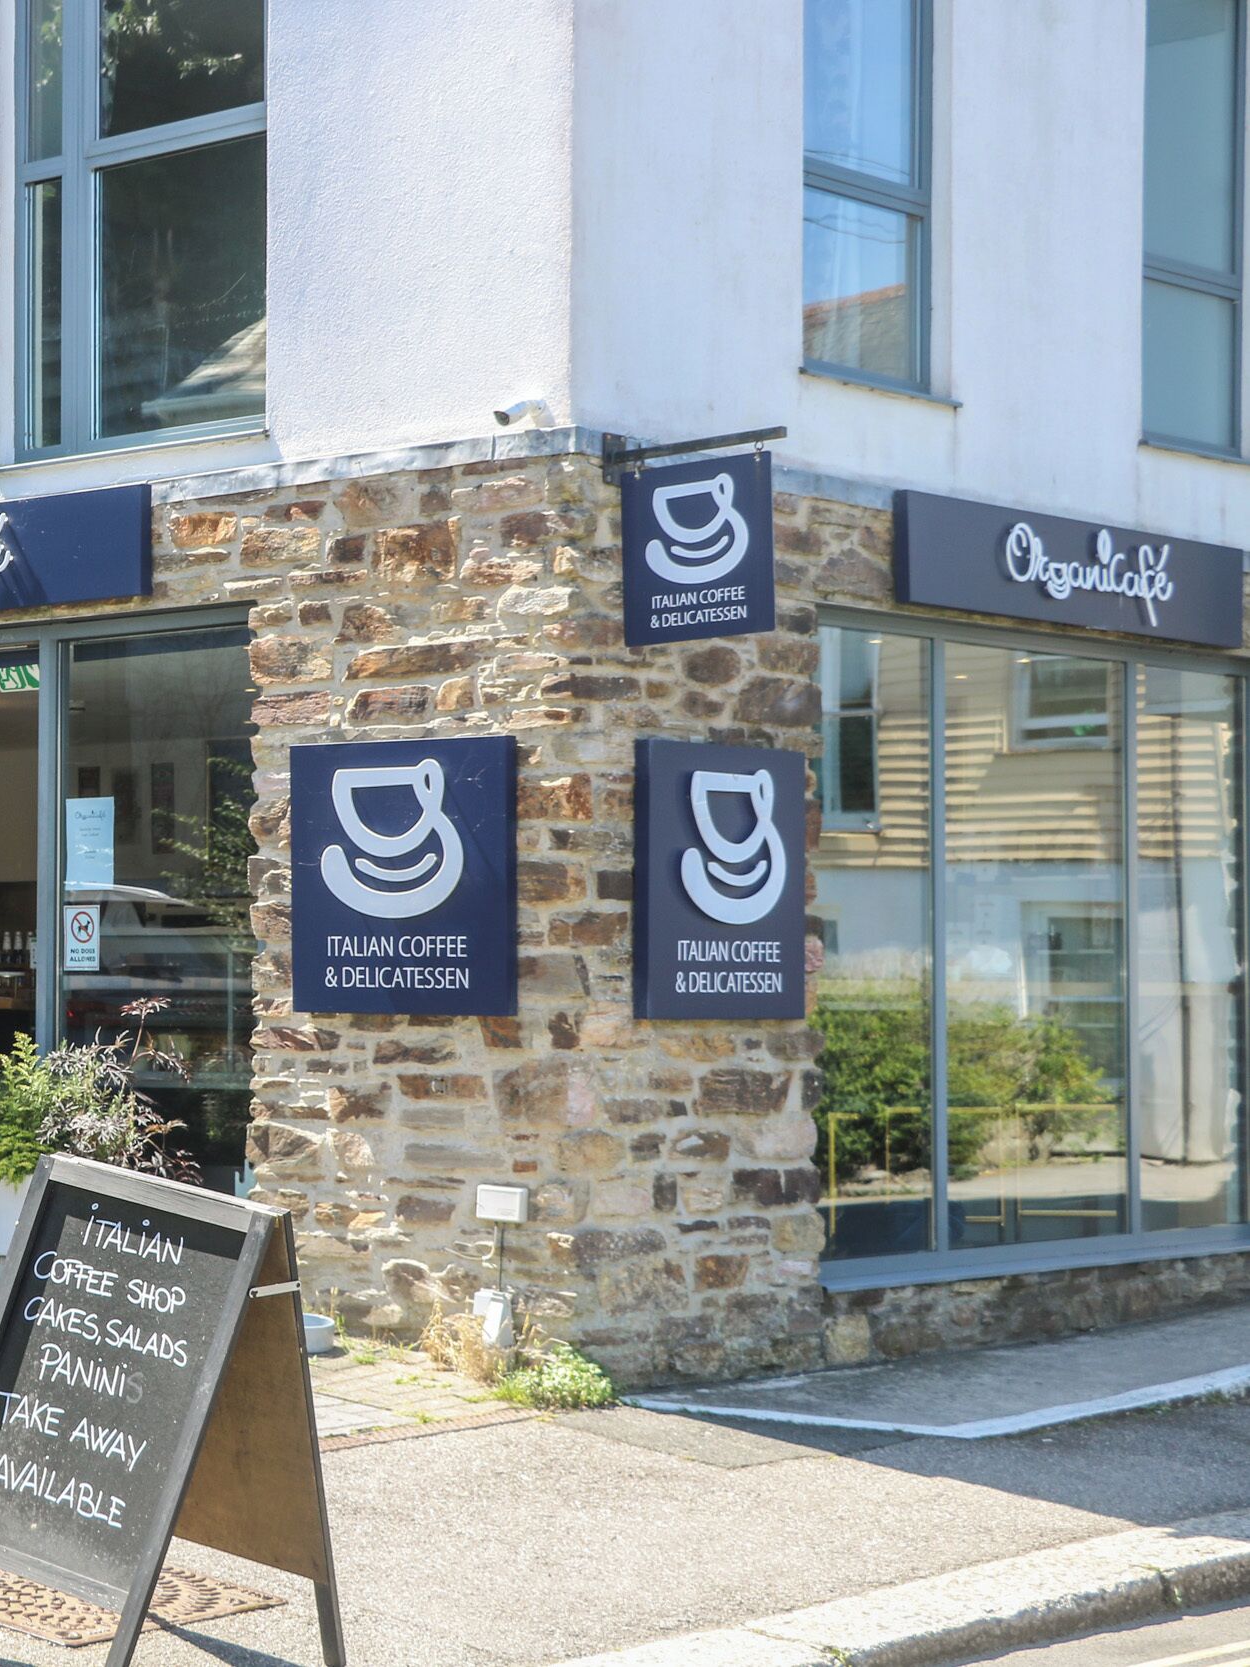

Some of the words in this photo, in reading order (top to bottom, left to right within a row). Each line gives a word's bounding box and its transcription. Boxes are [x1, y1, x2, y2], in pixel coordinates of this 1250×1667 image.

[651, 591, 697, 609] ITALIAN
[699, 585, 746, 604] COFFEE
[650, 614, 660, 628] &
[661, 605, 747, 628] DELICATESSEN
[327, 935, 394, 957] ITALIAN
[398, 935, 468, 958] COFFEE
[677, 940, 729, 961] ITALIAN
[731, 940, 781, 962] COFFEE
[324, 966, 338, 988] &
[341, 966, 470, 989] DELICATESSEN
[675, 971, 686, 993] &
[688, 971, 783, 993] DELICATESSEN
[33, 1250, 119, 1298] COFFEE
[126, 1278, 187, 1314] SHOP
[104, 1318, 188, 1368] SALADS
[69, 1416, 148, 1472] AWAY
